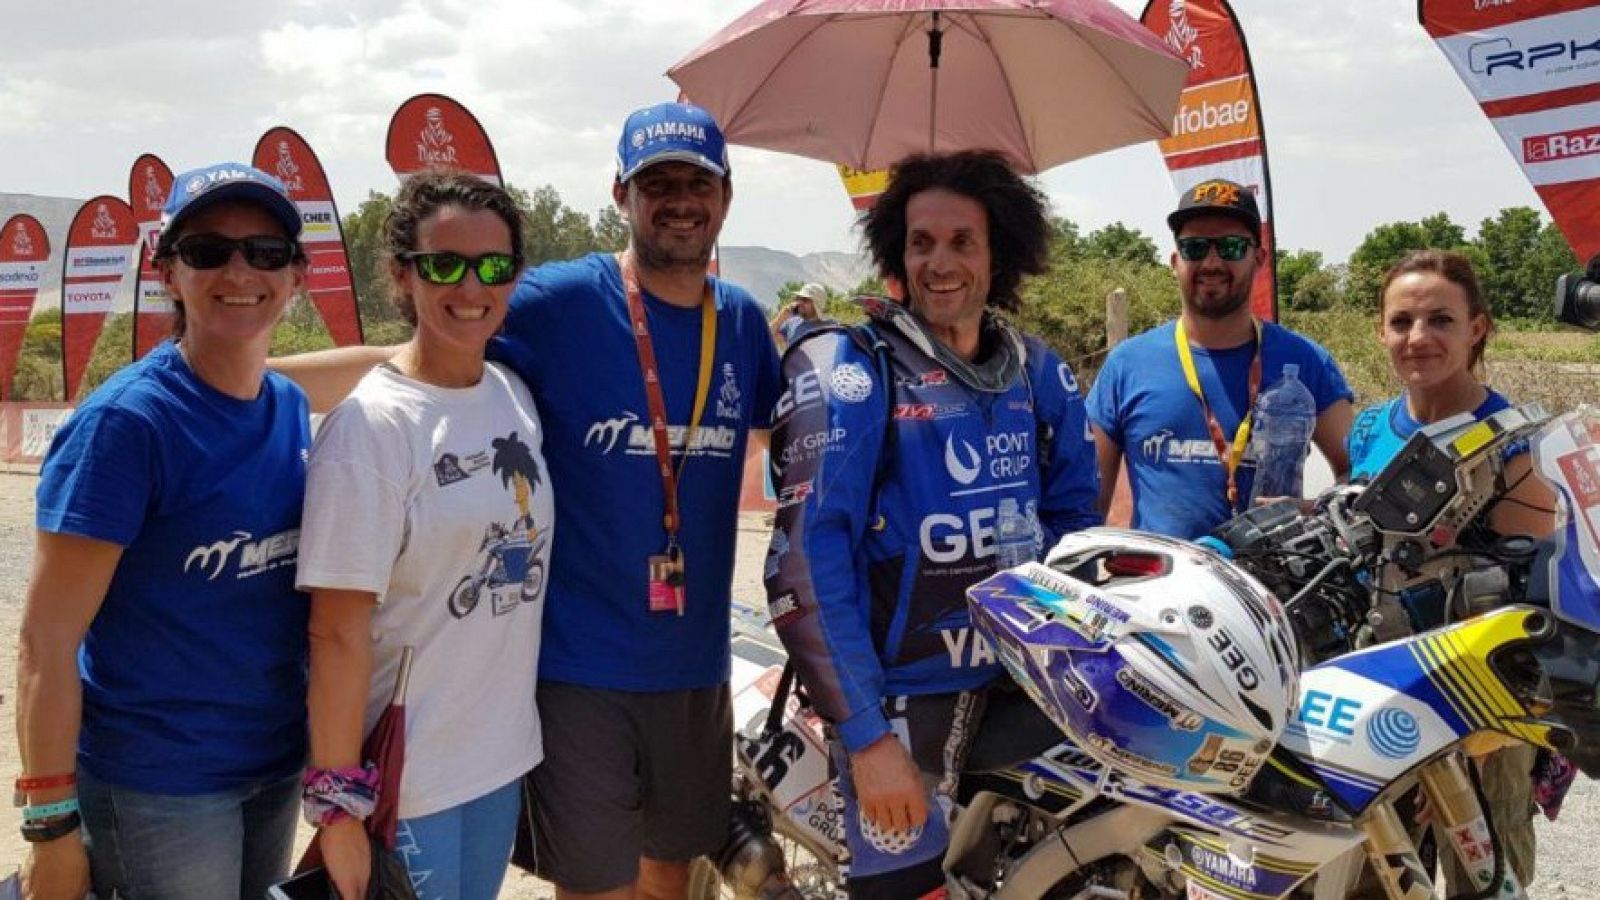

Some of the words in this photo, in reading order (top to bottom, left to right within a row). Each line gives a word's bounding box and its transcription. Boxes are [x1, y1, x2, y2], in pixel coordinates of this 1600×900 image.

[645, 122, 707, 141] YAMAHA
[1194, 181, 1240, 204] FOX
[303, 213, 332, 223] CHER
[67, 291, 113, 304] TOYOTA
[803, 428, 847, 450] GRUP
[985, 432, 1030, 455] PONT
[989, 456, 1031, 479] GRUP
[1207, 628, 1260, 691] GEE
[1298, 689, 1363, 735] EE
